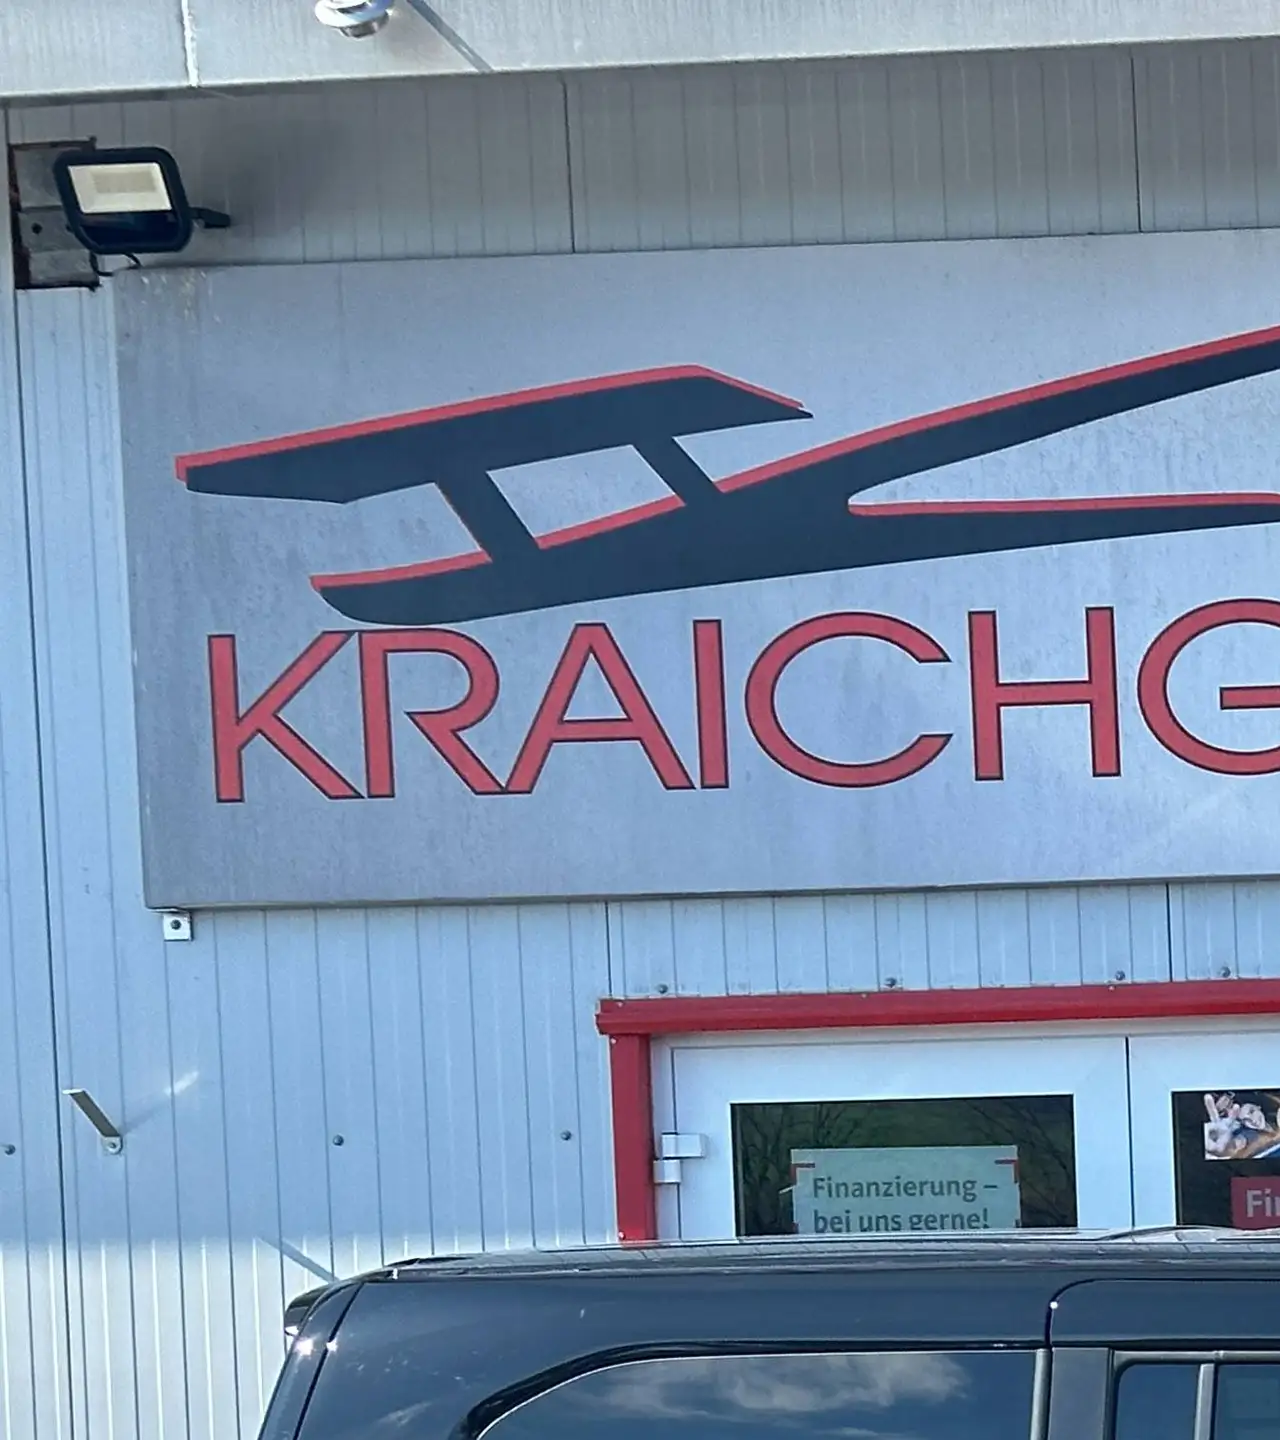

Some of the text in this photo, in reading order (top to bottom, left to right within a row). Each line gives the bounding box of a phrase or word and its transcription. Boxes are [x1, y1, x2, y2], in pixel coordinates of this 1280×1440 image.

[813, 1175, 977, 1203] Finanzierung
[814, 1208, 989, 1233] bei uns gerne!
